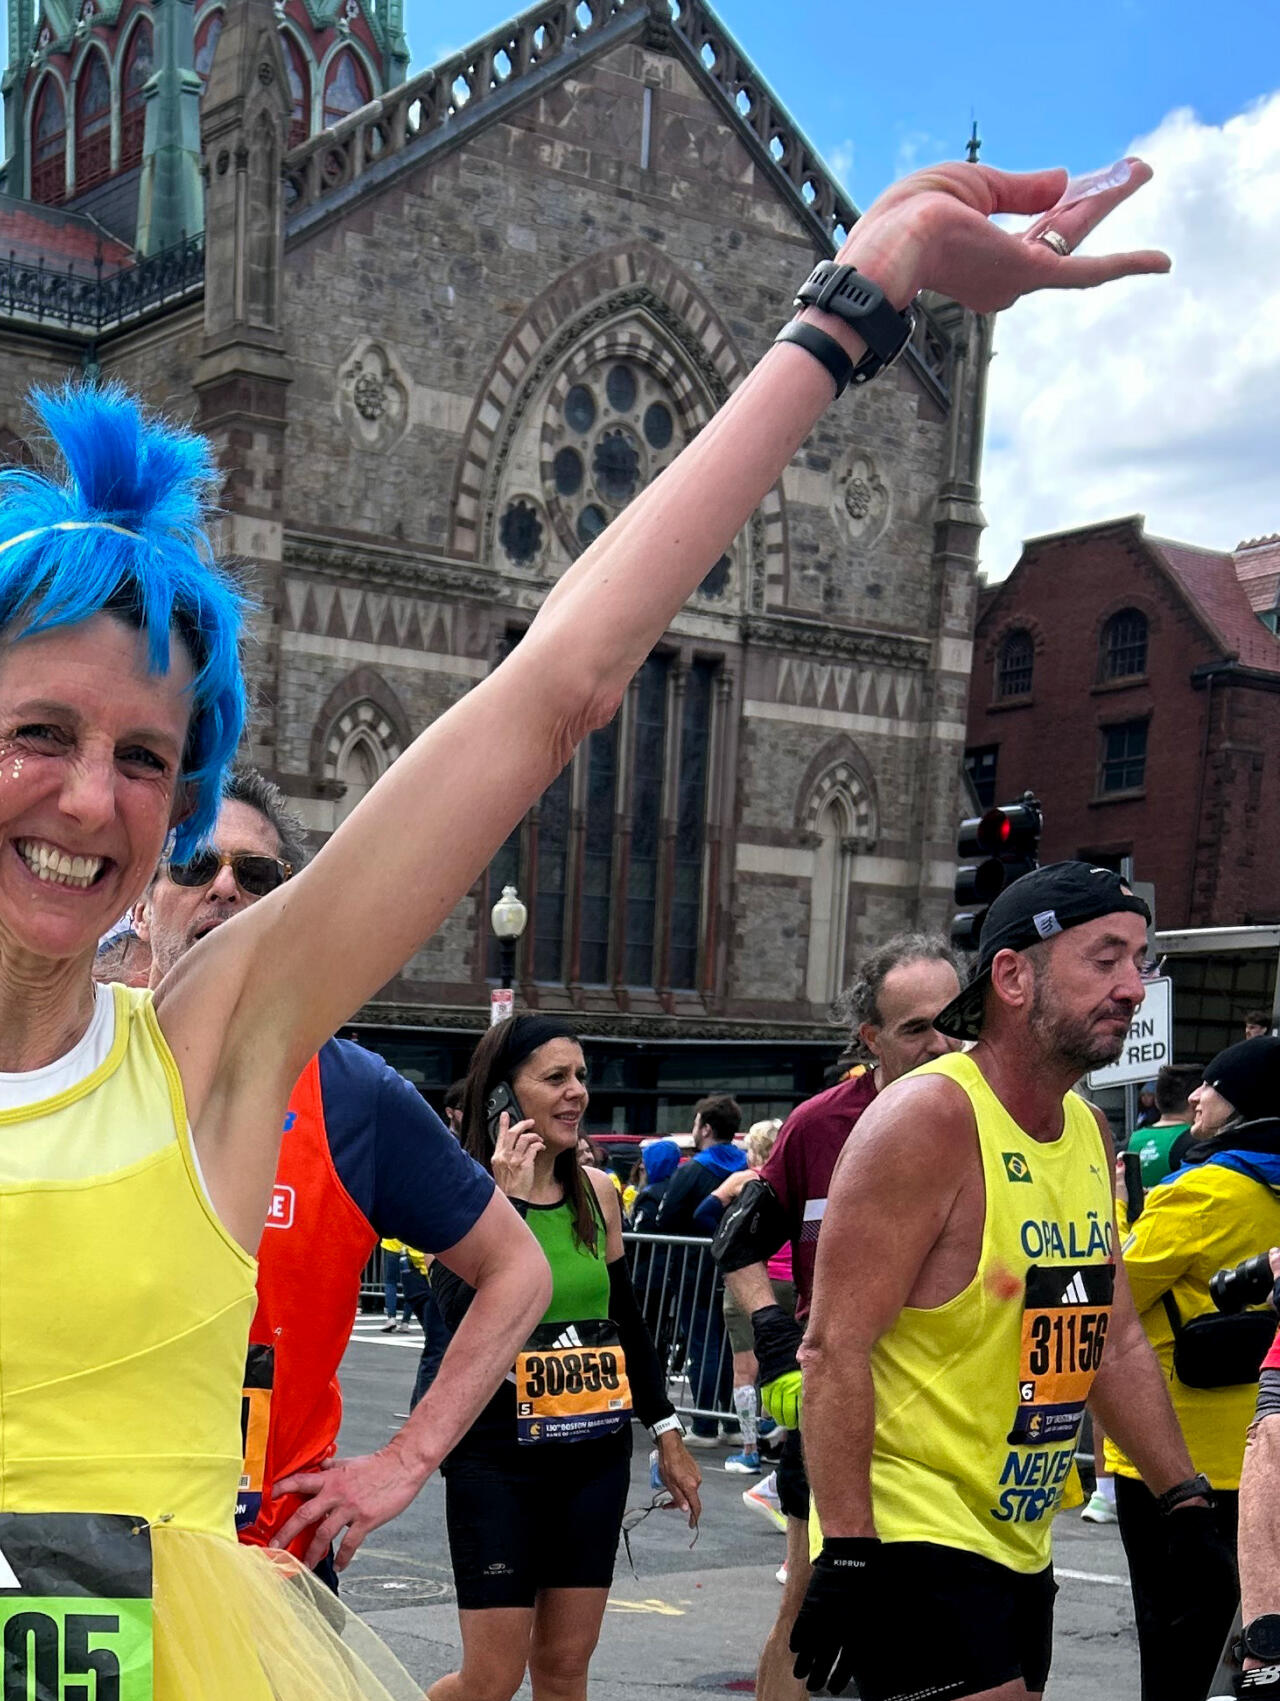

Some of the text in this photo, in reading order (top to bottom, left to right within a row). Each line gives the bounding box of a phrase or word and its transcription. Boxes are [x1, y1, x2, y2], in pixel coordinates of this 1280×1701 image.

[1129, 1018, 1154, 1040] RN
[1127, 1042, 1166, 1065] RED
[1021, 1211, 1115, 1259] OPALÃO
[1029, 1313, 1108, 1377] 31156
[525, 1351, 620, 1398] 30859
[1021, 1383, 1033, 1401] 6
[521, 1404, 531, 1416] 5
[998, 1450, 1073, 1487] NEVE
[990, 1487, 1057, 1523] STOP
[834, 1559, 866, 1567] KIPRUN
